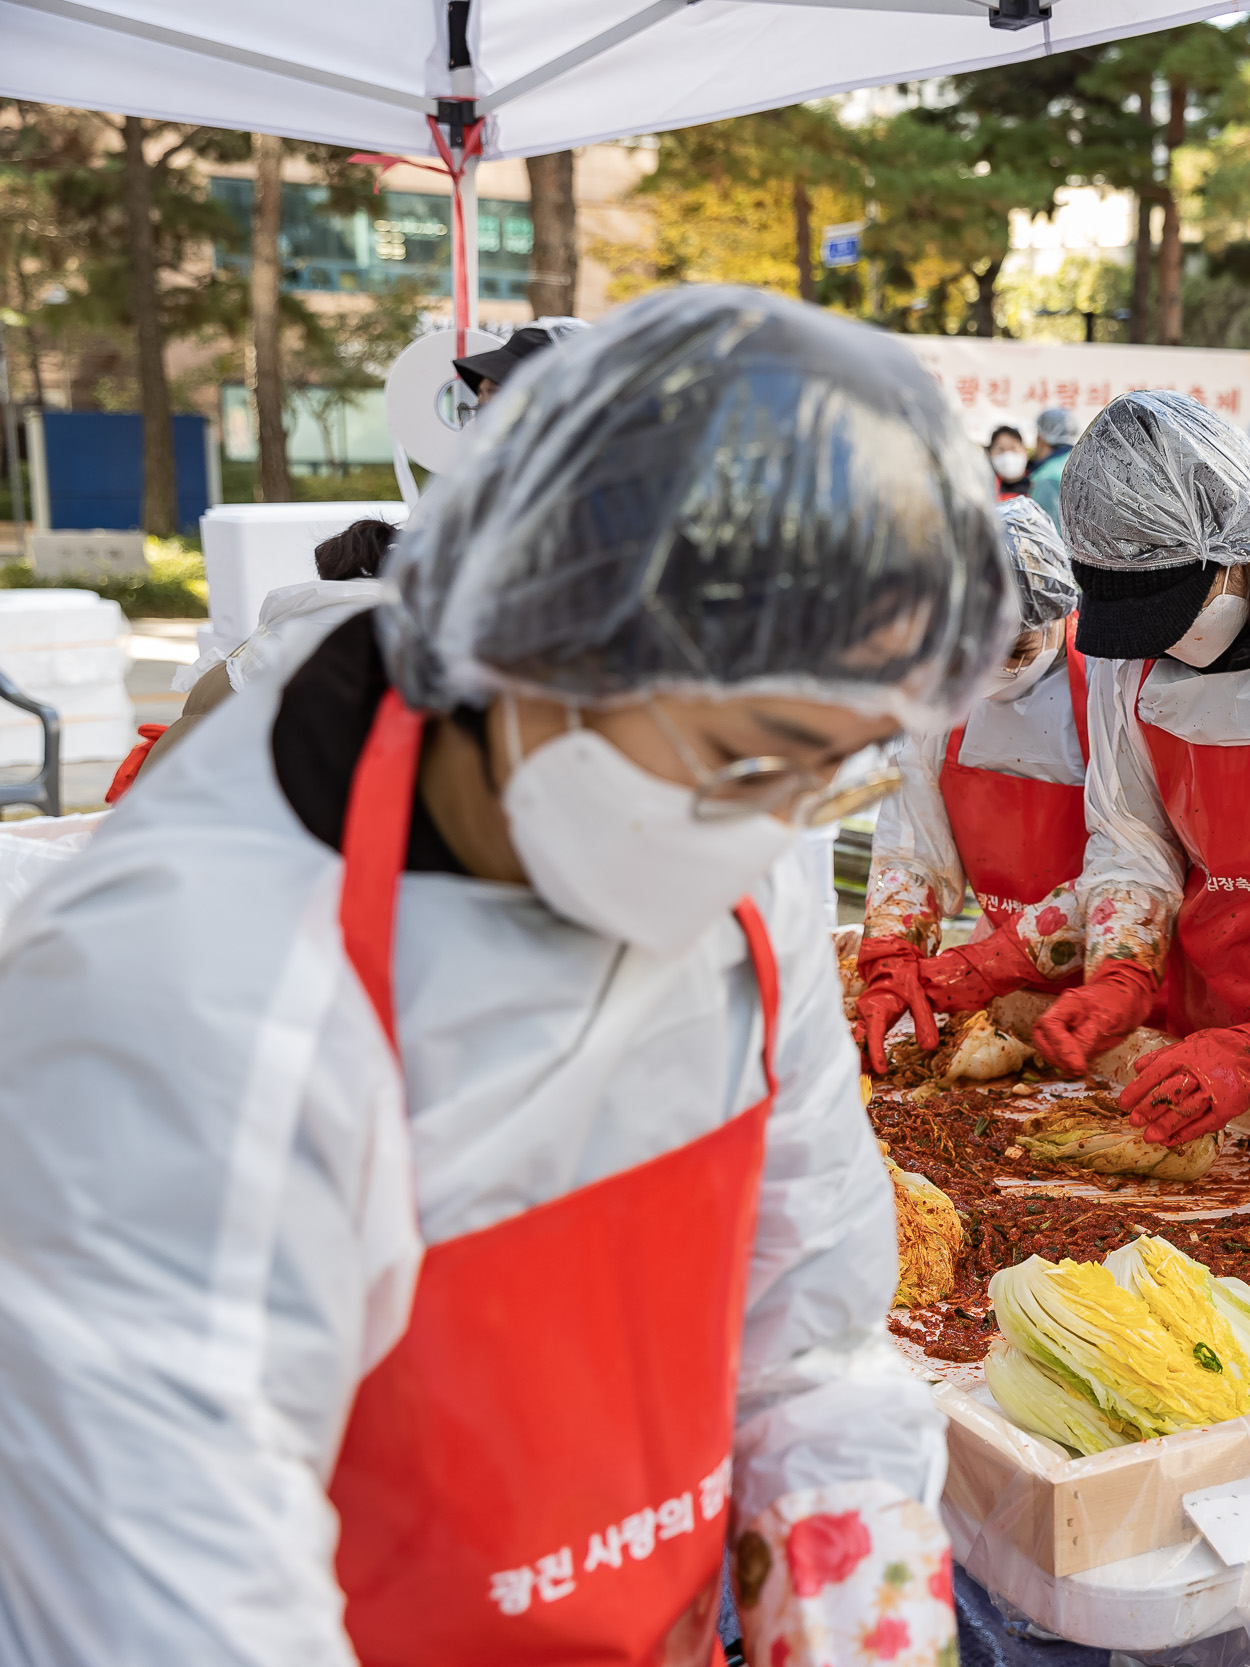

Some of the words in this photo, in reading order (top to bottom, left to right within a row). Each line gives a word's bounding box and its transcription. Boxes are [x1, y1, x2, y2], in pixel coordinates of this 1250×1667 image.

[957, 374, 1011, 408] 광진
[1022, 377, 1111, 408] 사랑의
[488, 1546, 577, 1616] 광진
[583, 1491, 695, 1573] 사랑의
